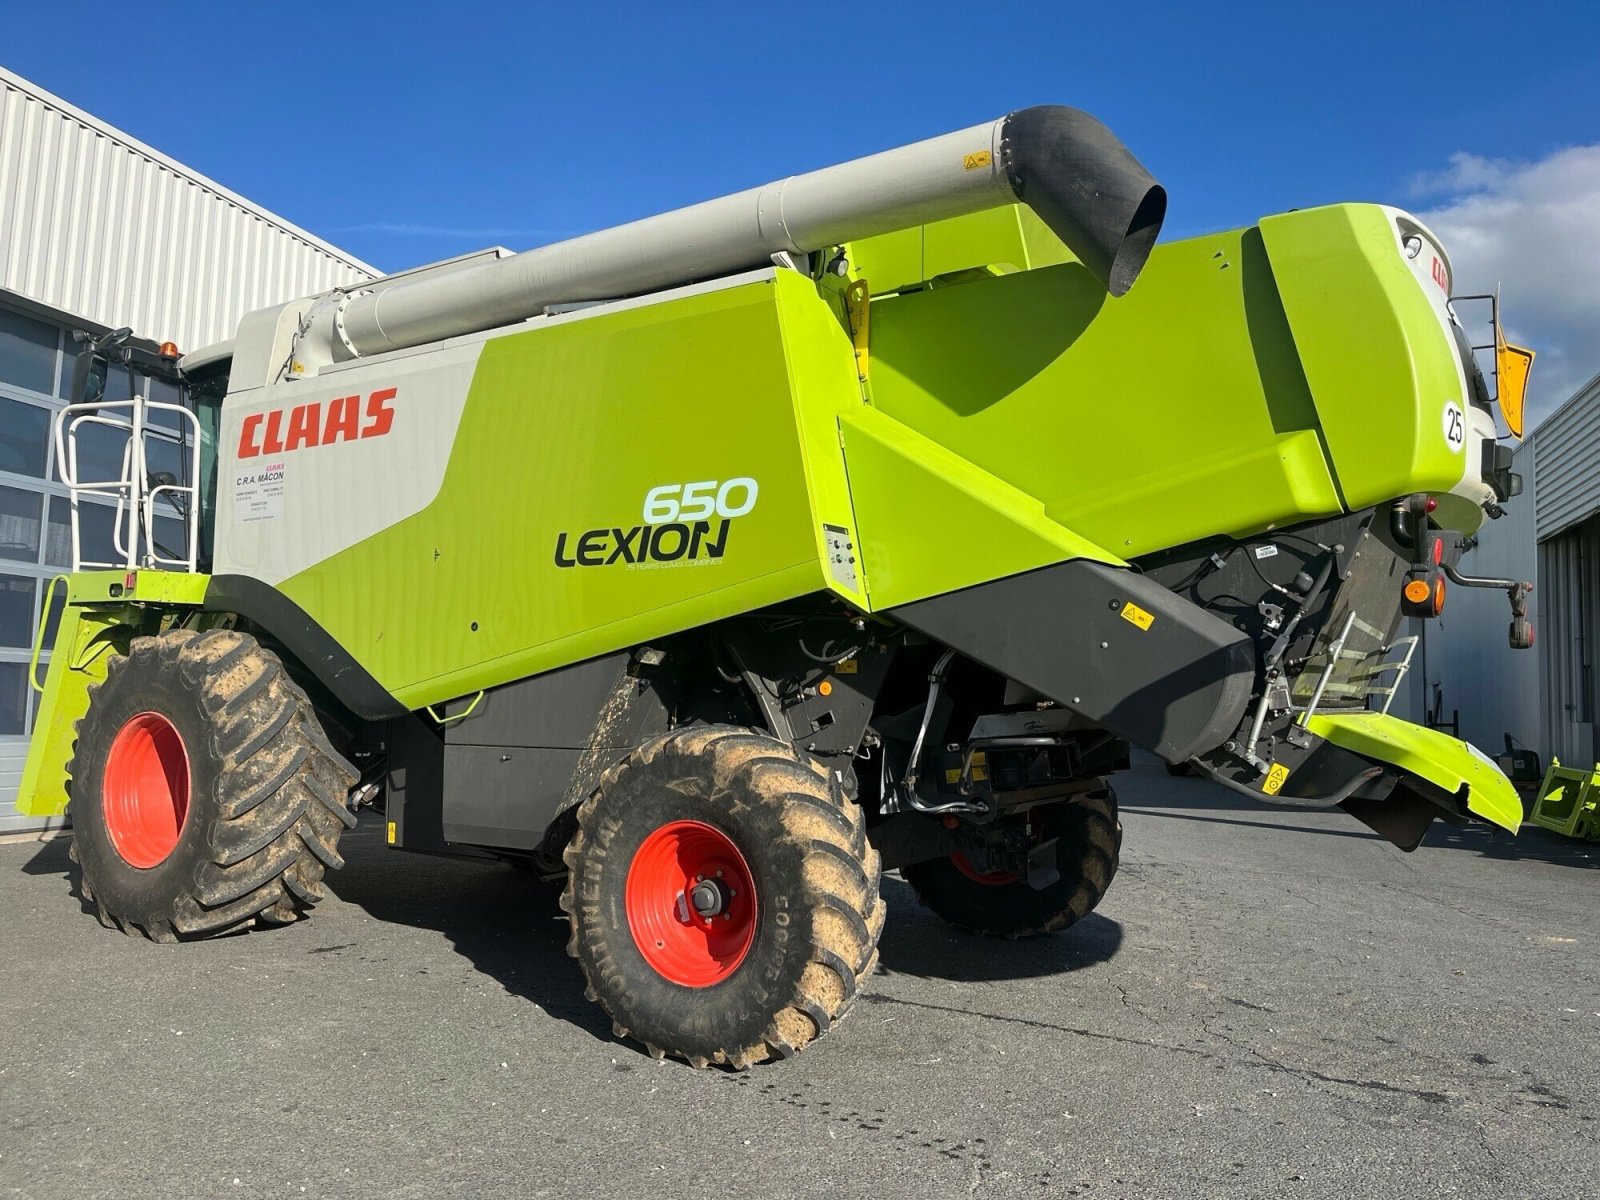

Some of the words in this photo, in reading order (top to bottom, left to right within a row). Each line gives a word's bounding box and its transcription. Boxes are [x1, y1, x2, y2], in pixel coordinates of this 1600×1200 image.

[238, 387, 398, 459] CLAAS
[1447, 407, 1463, 443] 25
[236, 476, 257, 486] C.R.A.
[643, 477, 759, 524] 650
[554, 518, 731, 568] LEXION
